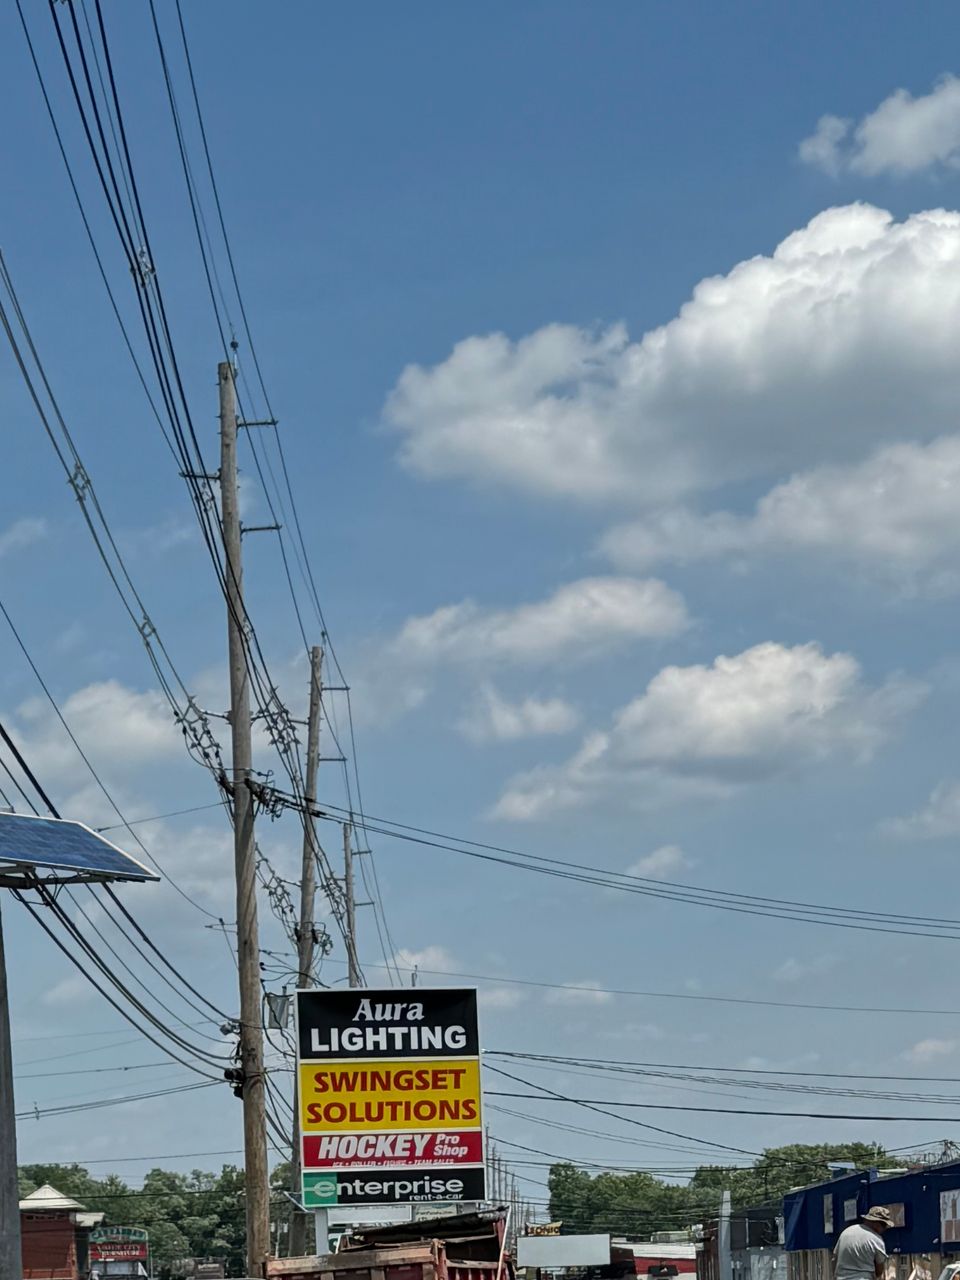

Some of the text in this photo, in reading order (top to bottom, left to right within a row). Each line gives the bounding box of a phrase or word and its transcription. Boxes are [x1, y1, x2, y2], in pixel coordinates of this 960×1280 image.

[352, 999, 425, 1022] Aura
[311, 1025, 467, 1052] LIGHTING
[313, 1068, 467, 1093] SWINGSET
[307, 1099, 477, 1123] SOLUTIONS
[318, 1134, 433, 1159] HOCKEY
[435, 1133, 460, 1145] Pro
[433, 1145, 468, 1158] Shop
[314, 1176, 464, 1199] enterprise
[409, 1193, 464, 1201] rent-a-car
